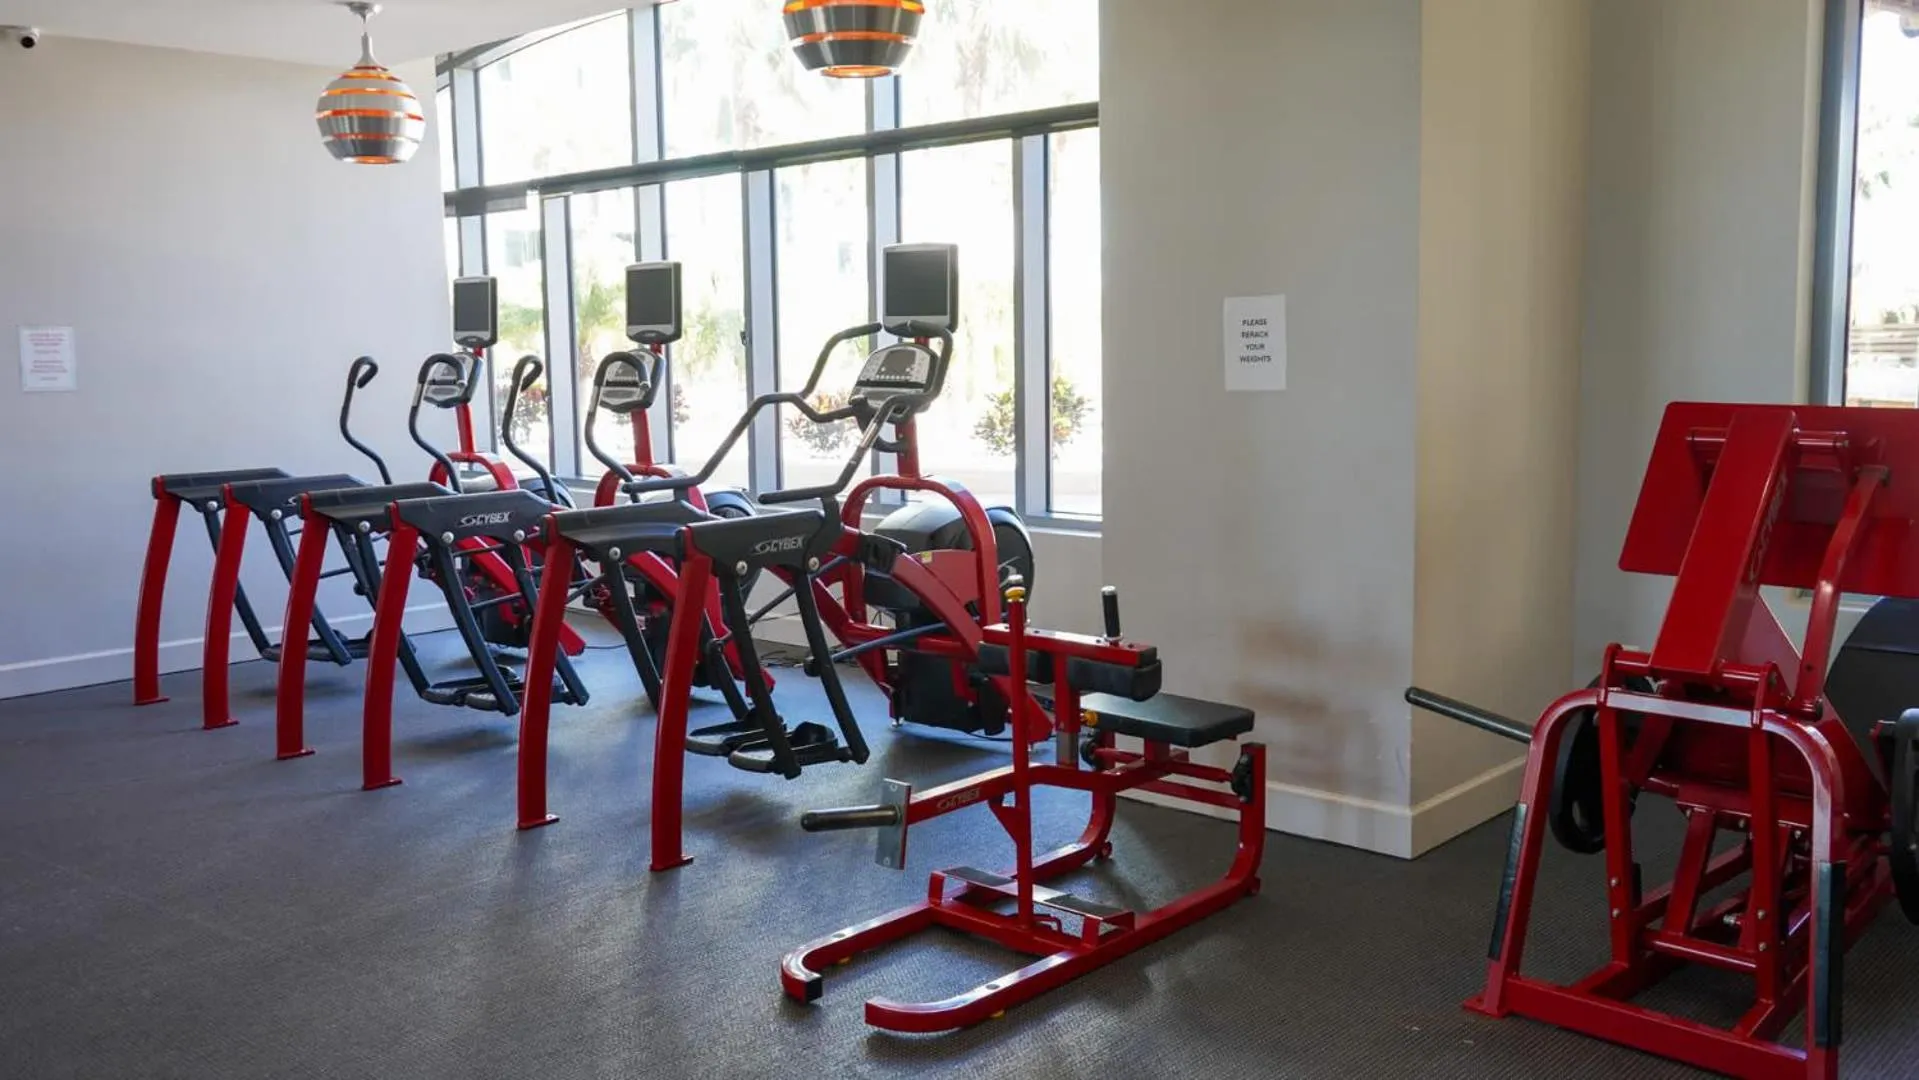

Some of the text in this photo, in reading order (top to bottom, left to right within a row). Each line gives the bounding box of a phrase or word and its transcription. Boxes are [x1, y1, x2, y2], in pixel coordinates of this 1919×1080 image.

[1241, 318, 1267, 326] PLEASE
[474, 511, 512, 526] CYBEX
[768, 536, 805, 553] CYBEX
